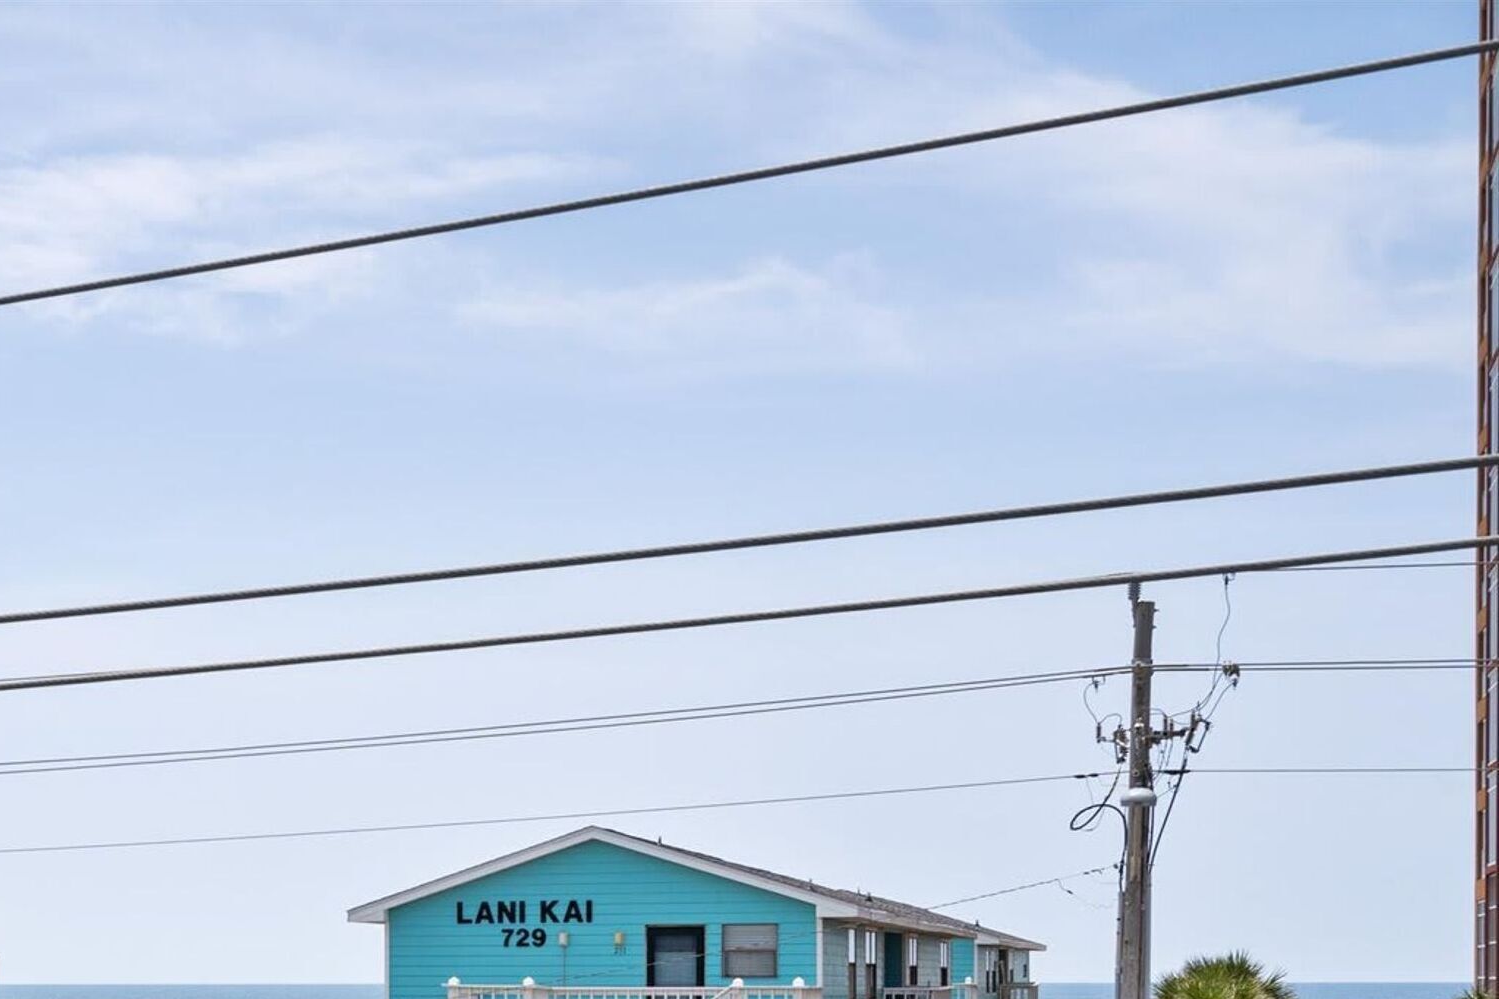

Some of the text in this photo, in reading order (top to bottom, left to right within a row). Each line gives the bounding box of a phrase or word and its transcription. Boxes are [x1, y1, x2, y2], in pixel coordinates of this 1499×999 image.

[456, 900, 593, 924] LANI KAI
[501, 928, 547, 947] 729
